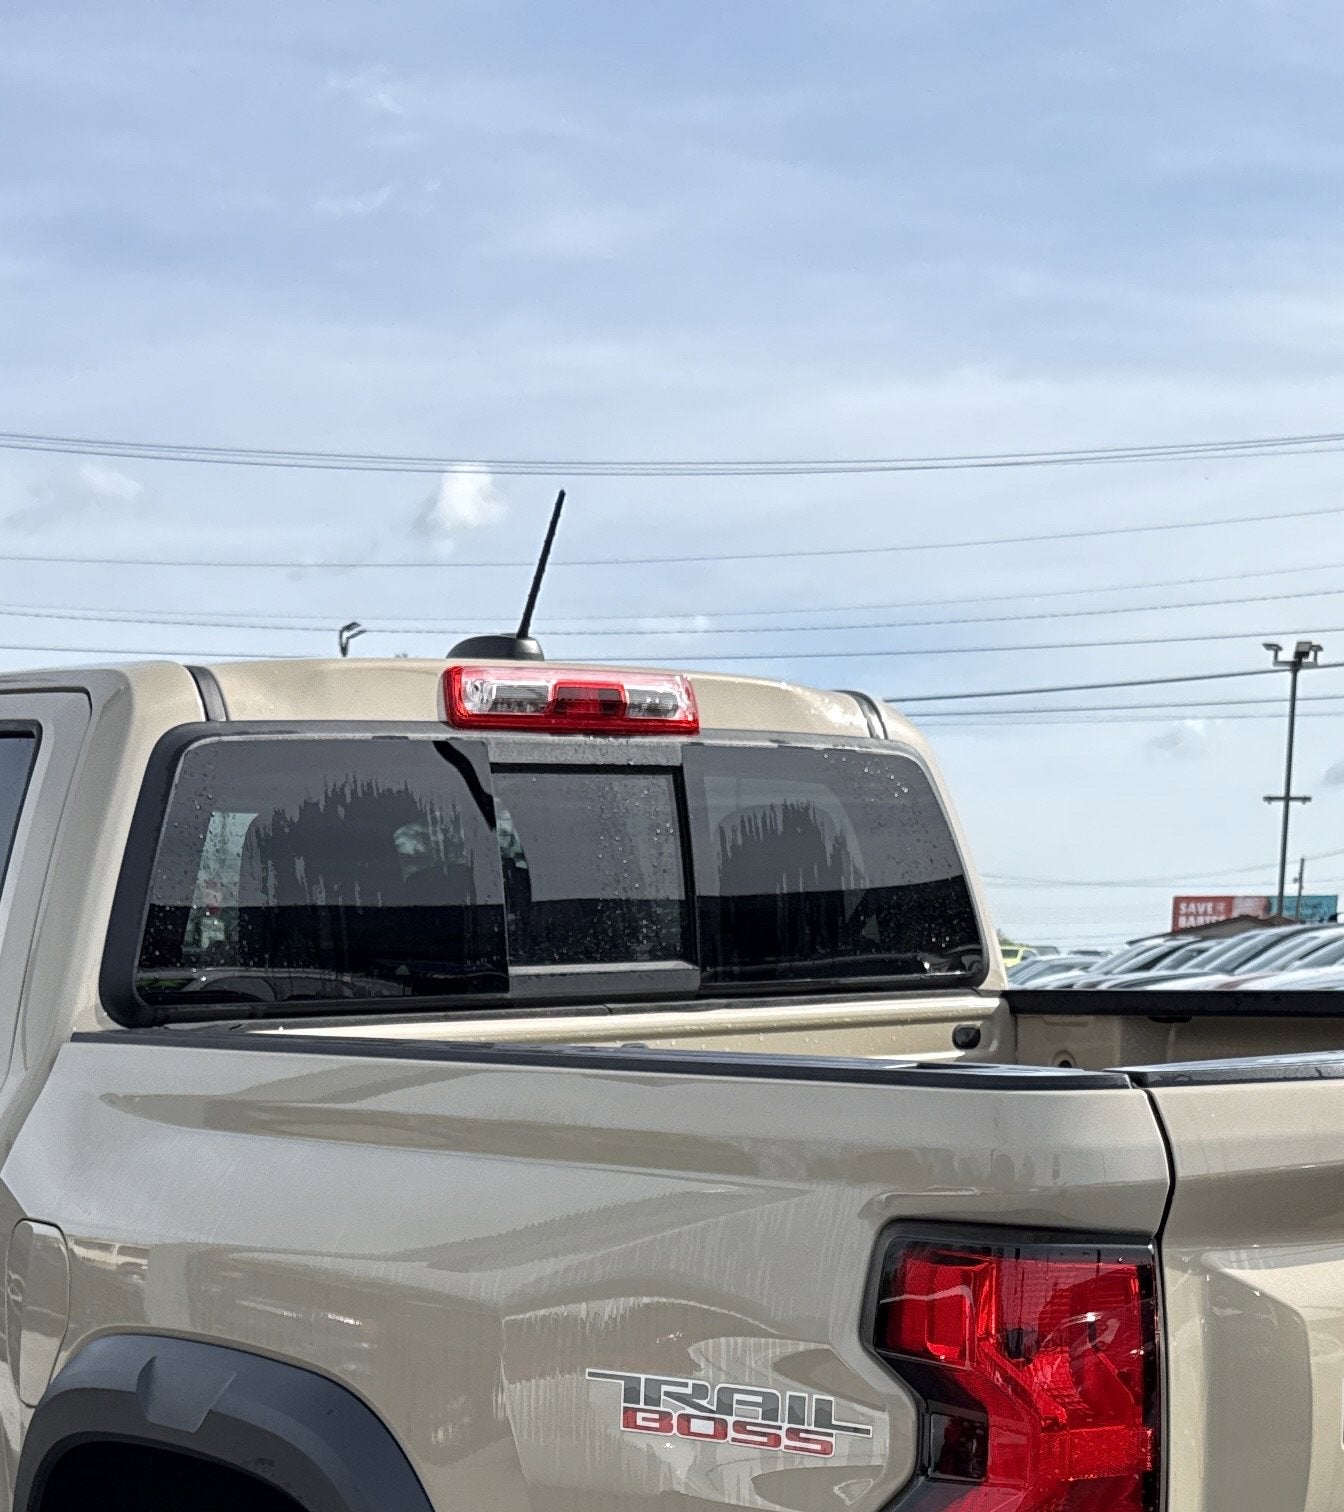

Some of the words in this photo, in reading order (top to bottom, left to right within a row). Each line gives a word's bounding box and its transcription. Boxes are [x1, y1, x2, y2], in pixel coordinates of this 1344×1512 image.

[1178, 902, 1214, 915] SAVE
[585, 1368, 873, 1438] TRAIL
[619, 1405, 835, 1459] BOSS
